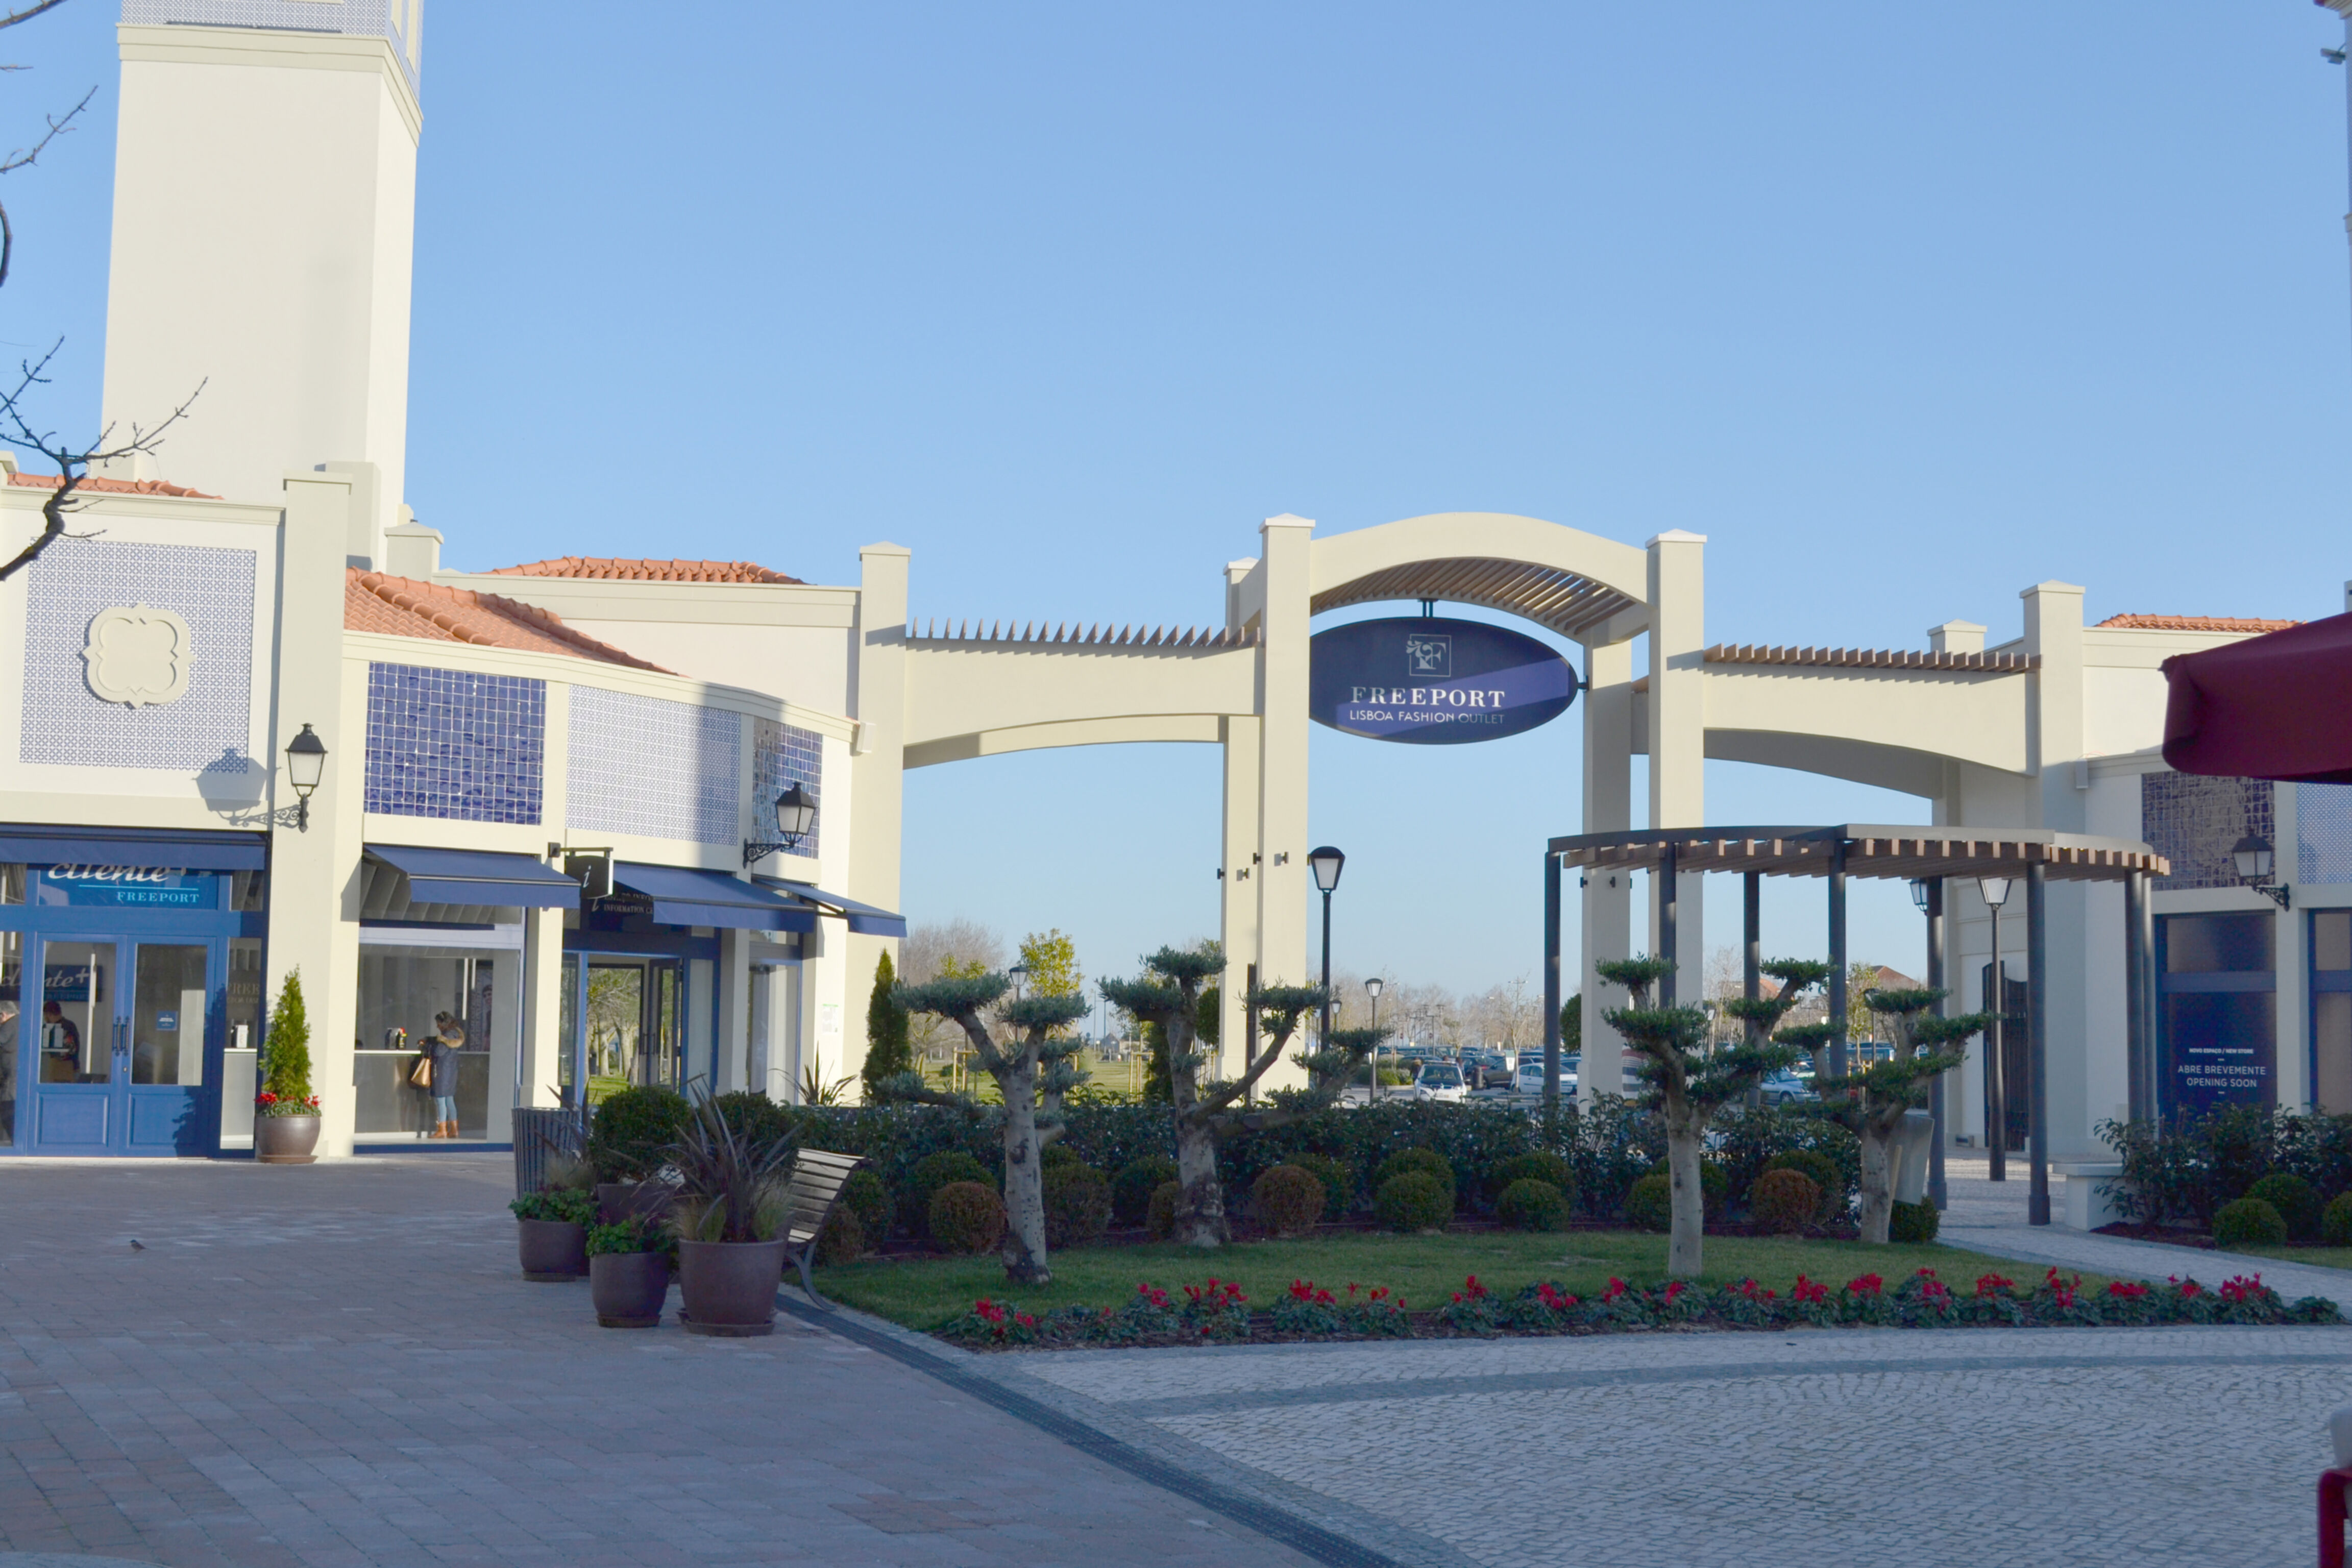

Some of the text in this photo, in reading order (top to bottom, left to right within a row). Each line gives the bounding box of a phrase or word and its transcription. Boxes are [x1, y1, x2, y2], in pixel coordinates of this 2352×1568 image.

[1350, 687, 1505, 707] FREEPORT
[1350, 710, 1505, 724] LISBOA FASHION OUTLET
[583, 865, 591, 888] i
[117, 892, 200, 903] FREEPORT
[604, 904, 645, 914] INFORMATION
[2178, 1065, 2266, 1075] ABRE BREVEMENTE
[2187, 1077, 2257, 1087] OPENING SOON
